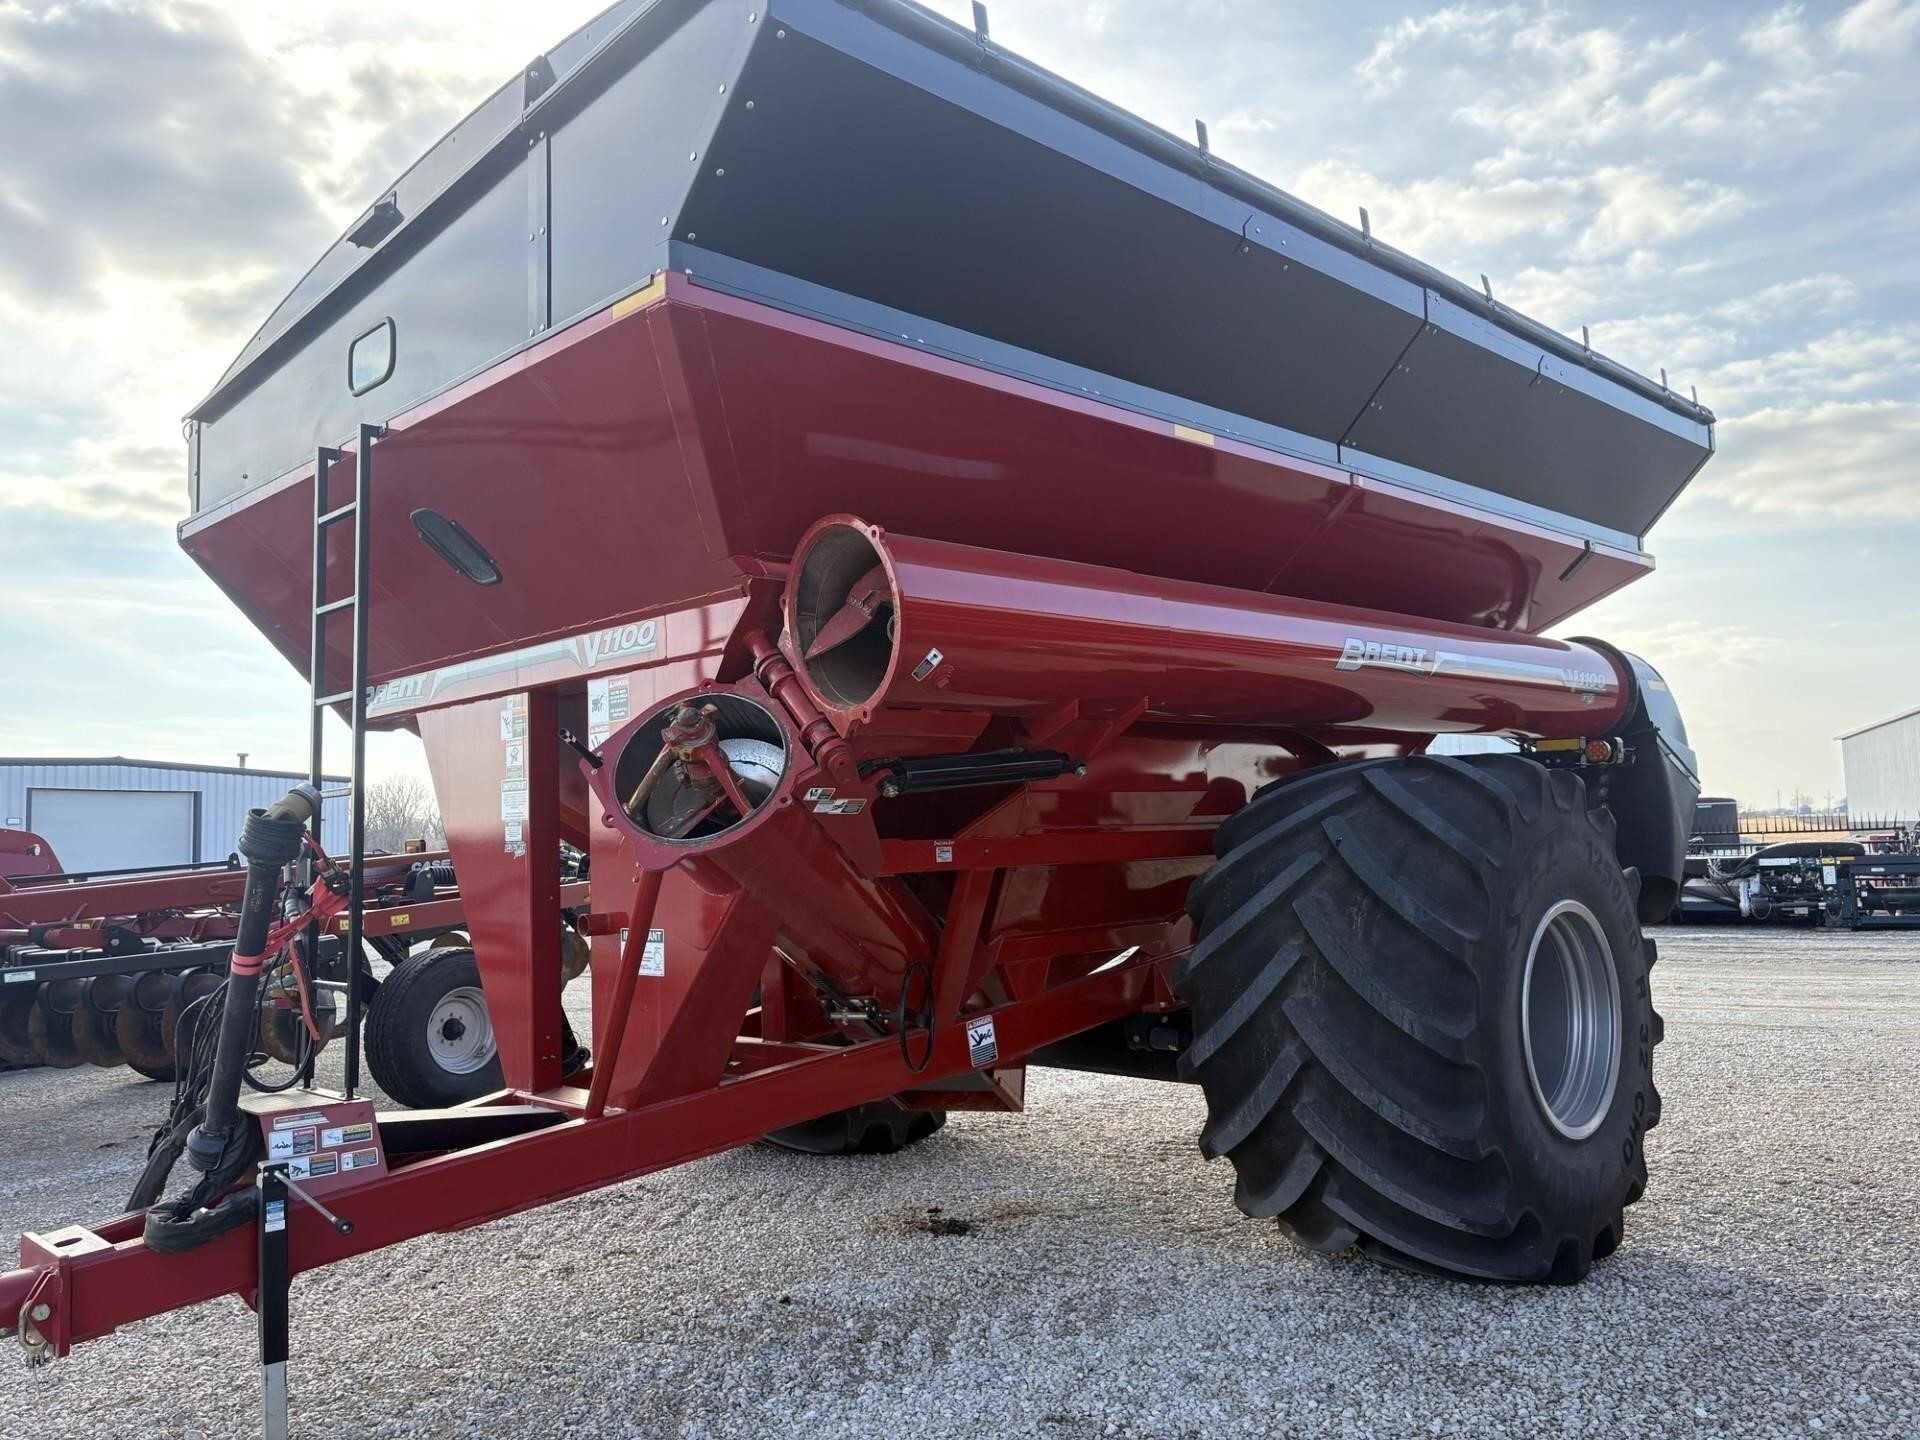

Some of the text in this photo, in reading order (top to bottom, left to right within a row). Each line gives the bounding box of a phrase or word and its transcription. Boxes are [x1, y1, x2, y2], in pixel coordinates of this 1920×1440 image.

[583, 620, 656, 668] V1100
[1335, 637, 1428, 671] BRENT
[411, 859, 451, 871] CASE
[1639, 1023, 1649, 1070] 32
[1623, 1091, 1645, 1166] CHO
